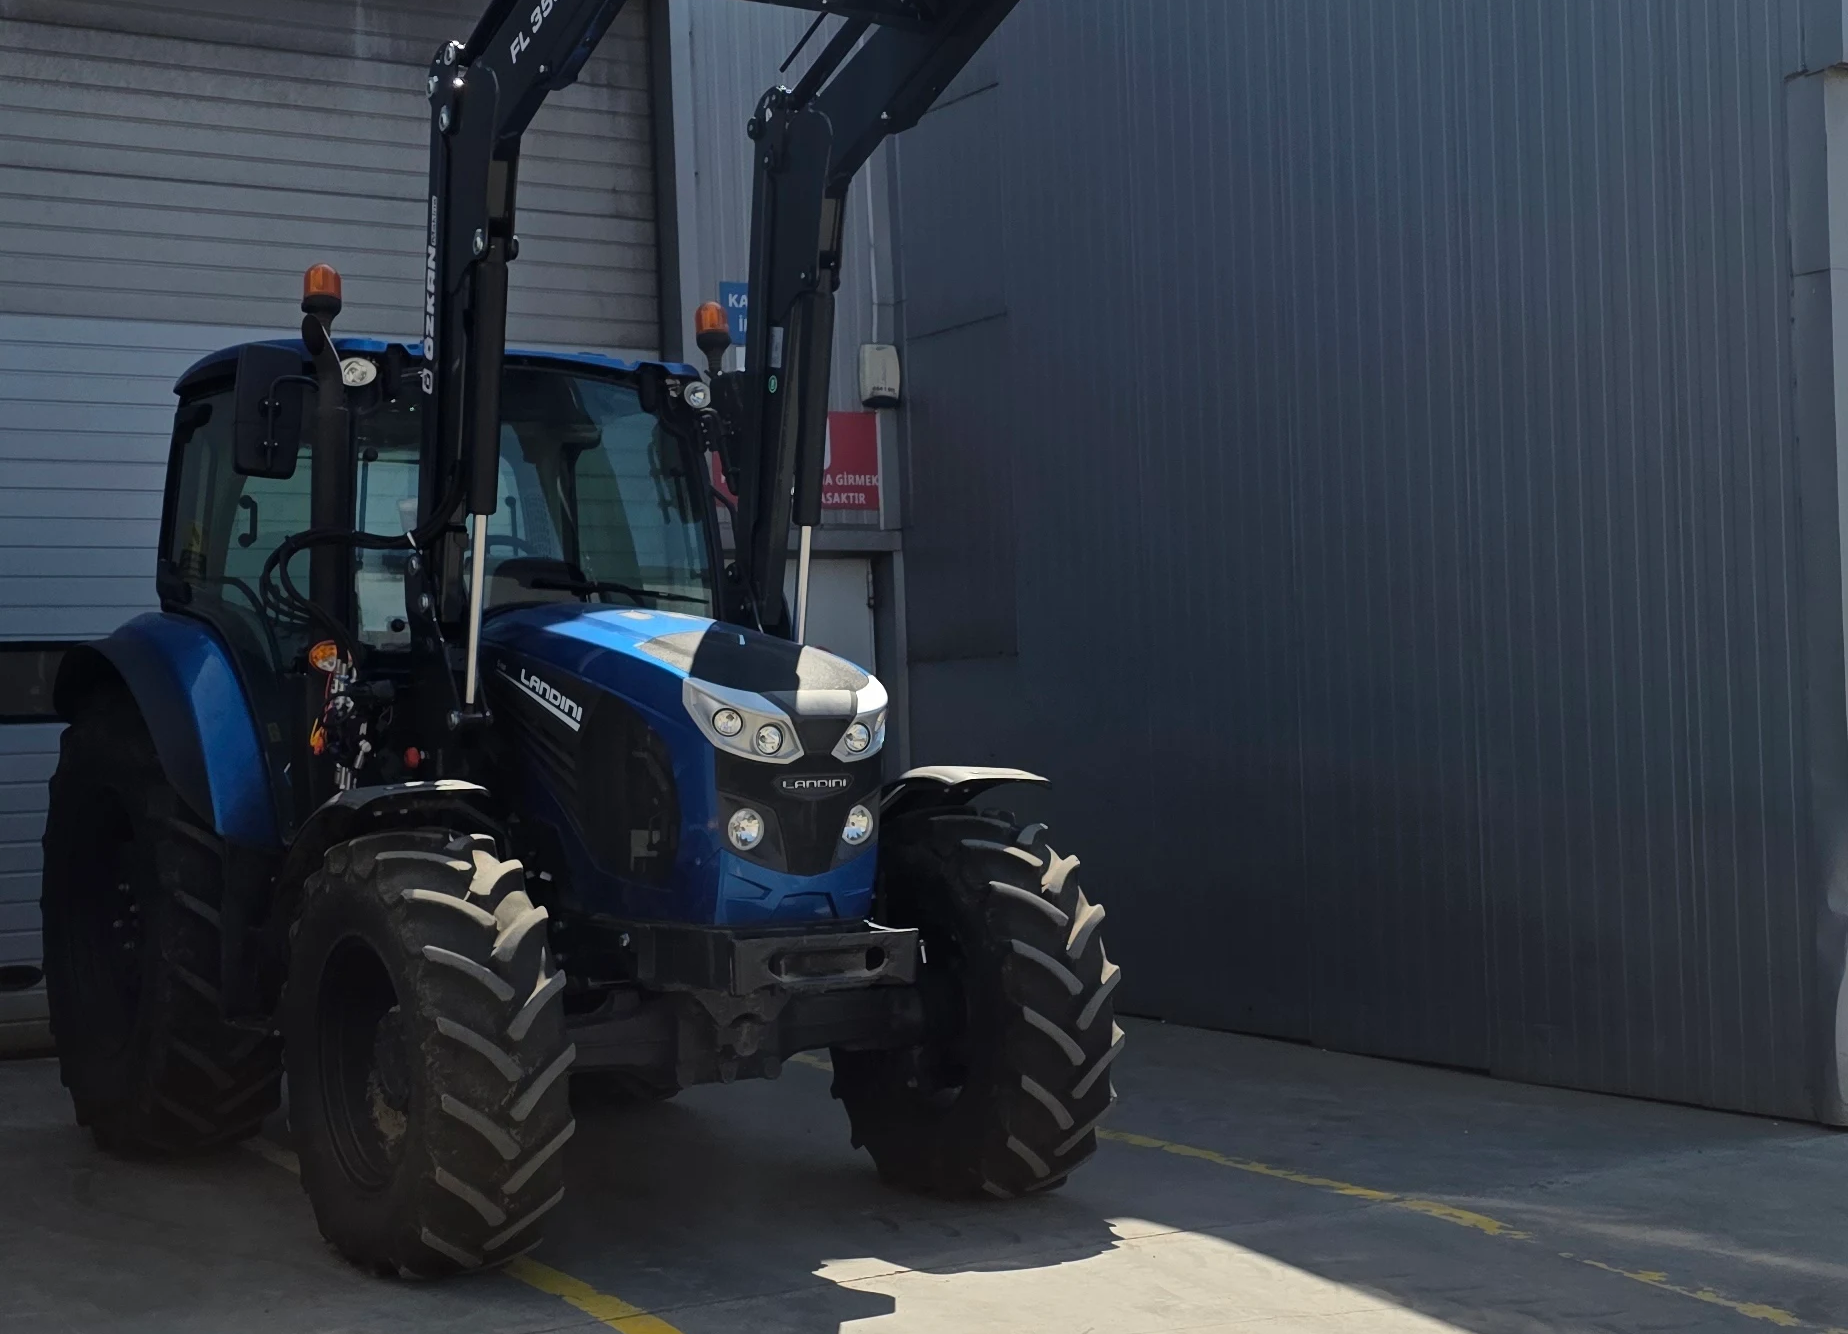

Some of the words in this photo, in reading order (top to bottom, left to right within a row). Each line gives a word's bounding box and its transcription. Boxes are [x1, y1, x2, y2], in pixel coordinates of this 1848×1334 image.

[509, 31, 531, 64] FL
[835, 471, 879, 486] GİRMEK
[520, 668, 583, 722] LANDINI
[782, 778, 847, 789] LANDINI
